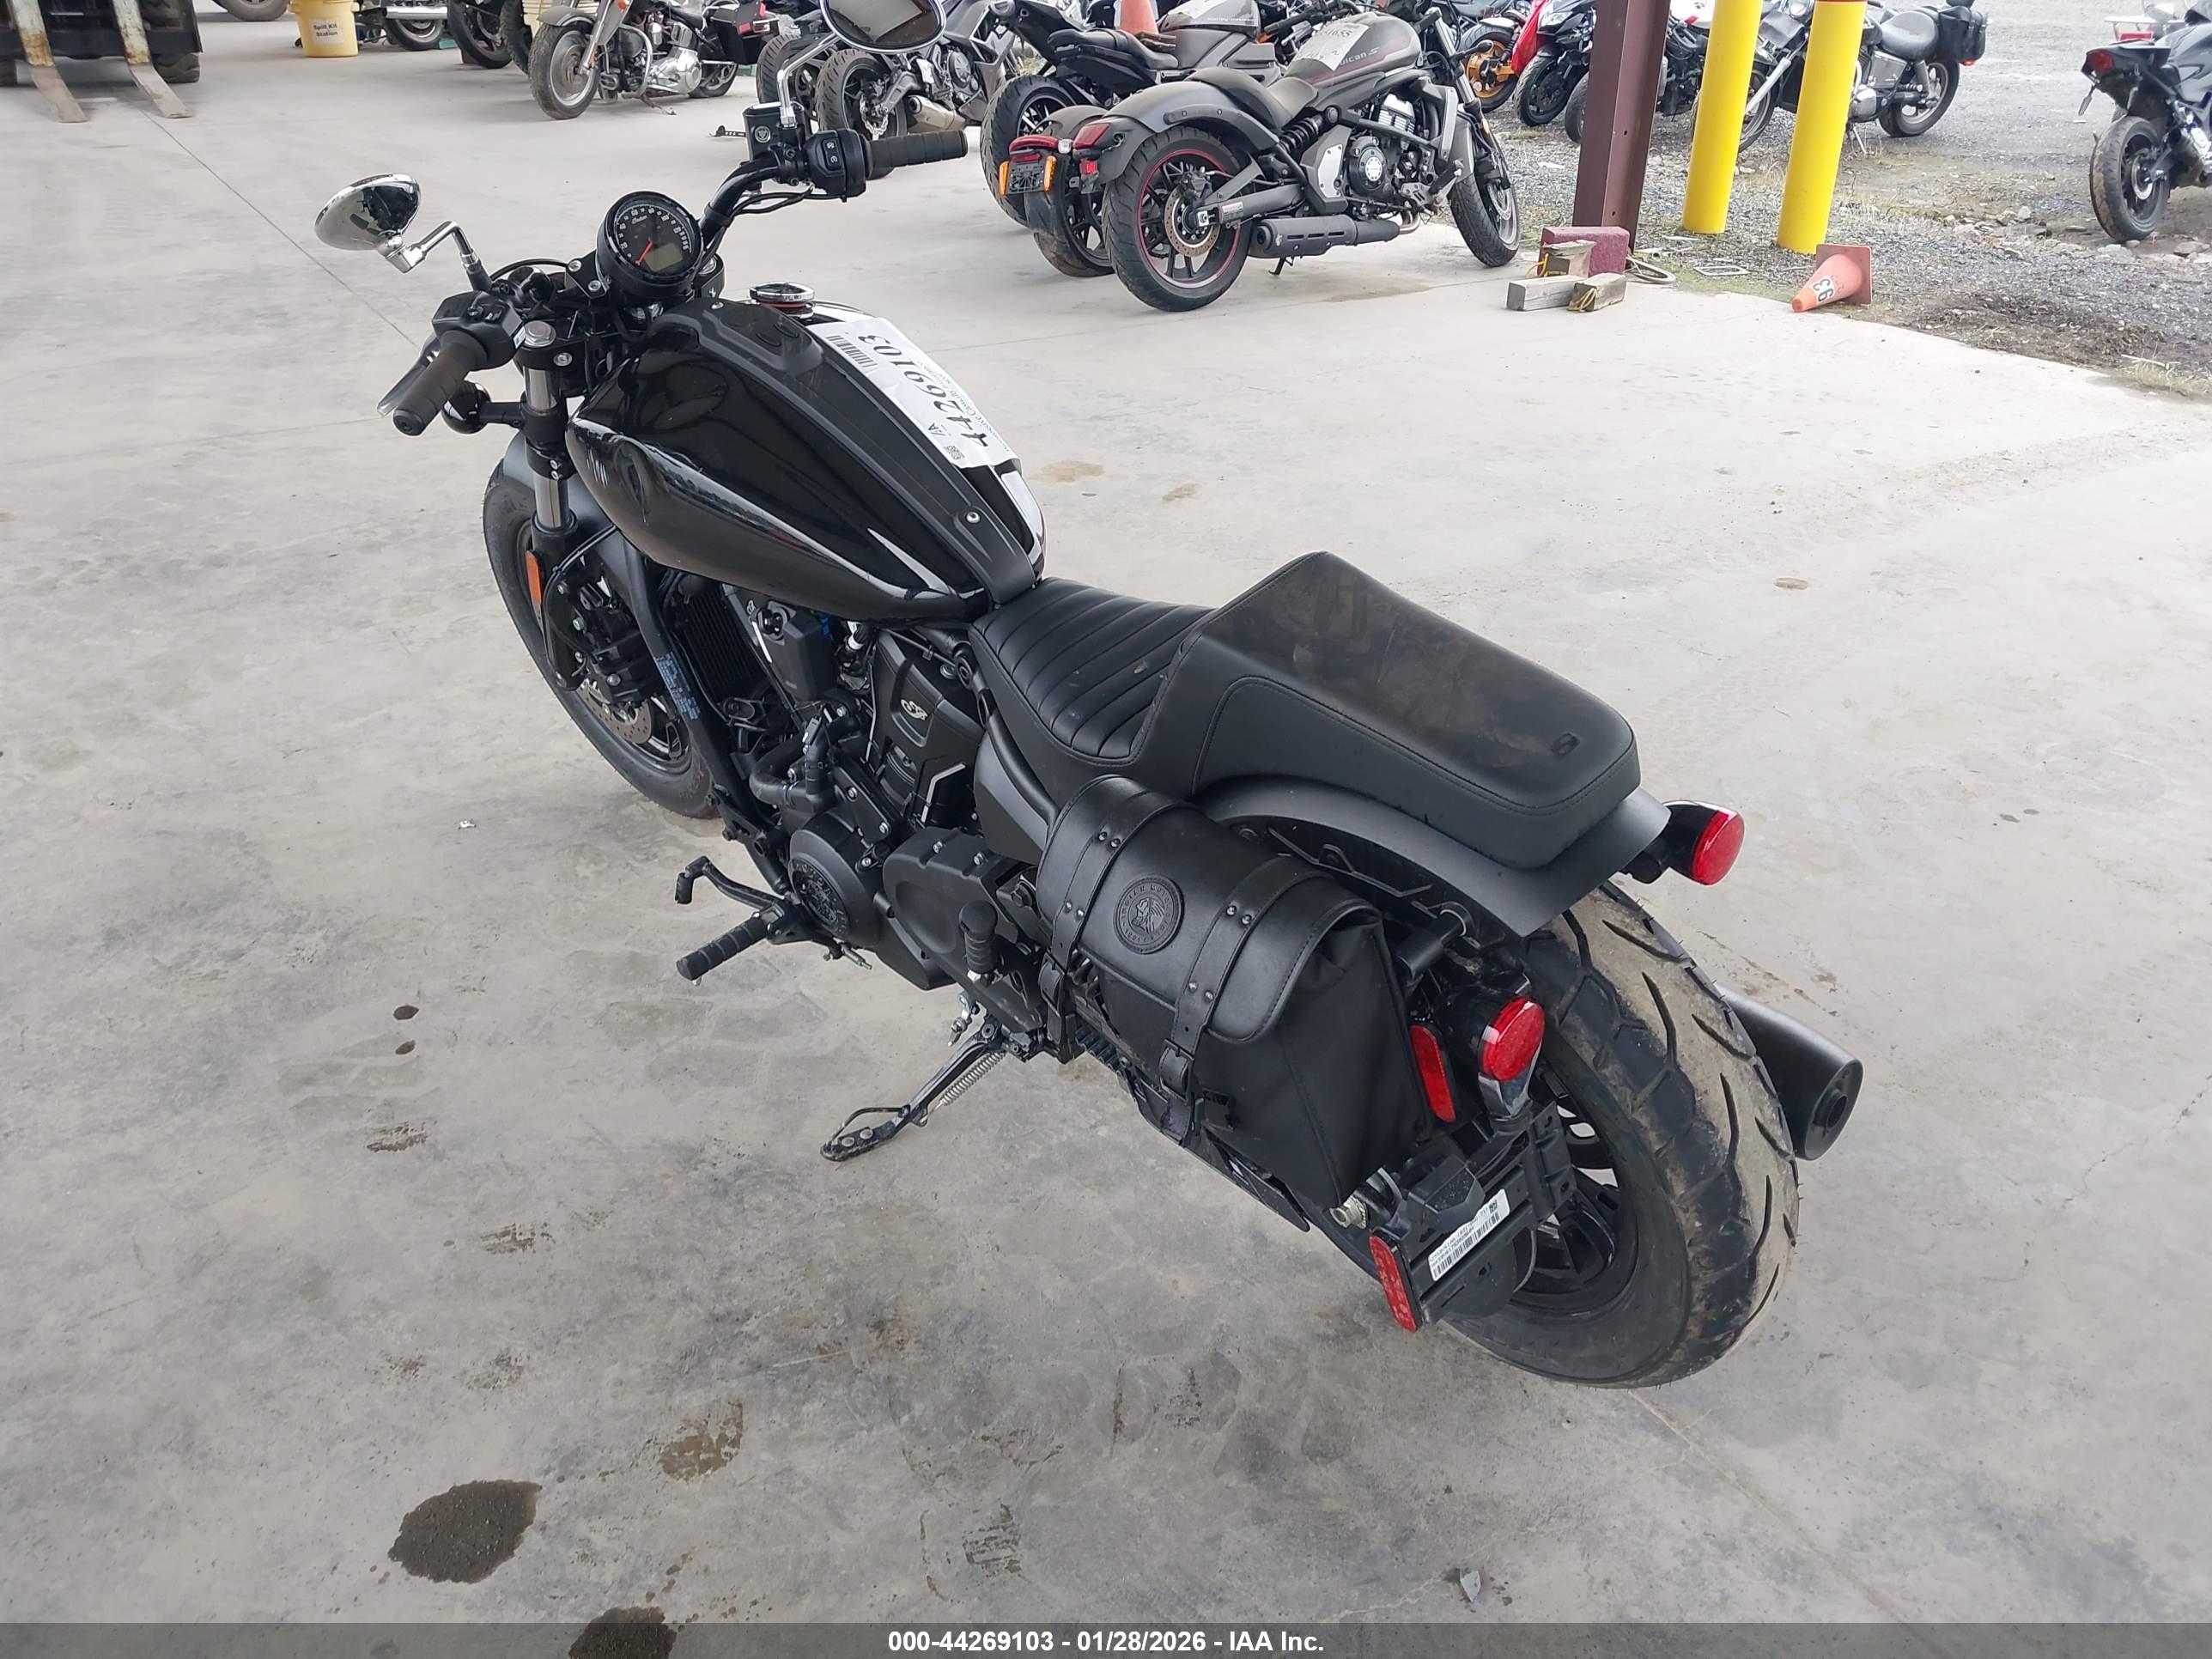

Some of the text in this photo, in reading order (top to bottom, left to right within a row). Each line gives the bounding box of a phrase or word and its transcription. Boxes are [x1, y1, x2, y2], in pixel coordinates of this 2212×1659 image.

[1340, 52, 1367, 65] ulcan
[1812, 278, 1834, 302] 93
[857, 333, 989, 448] 44269103
